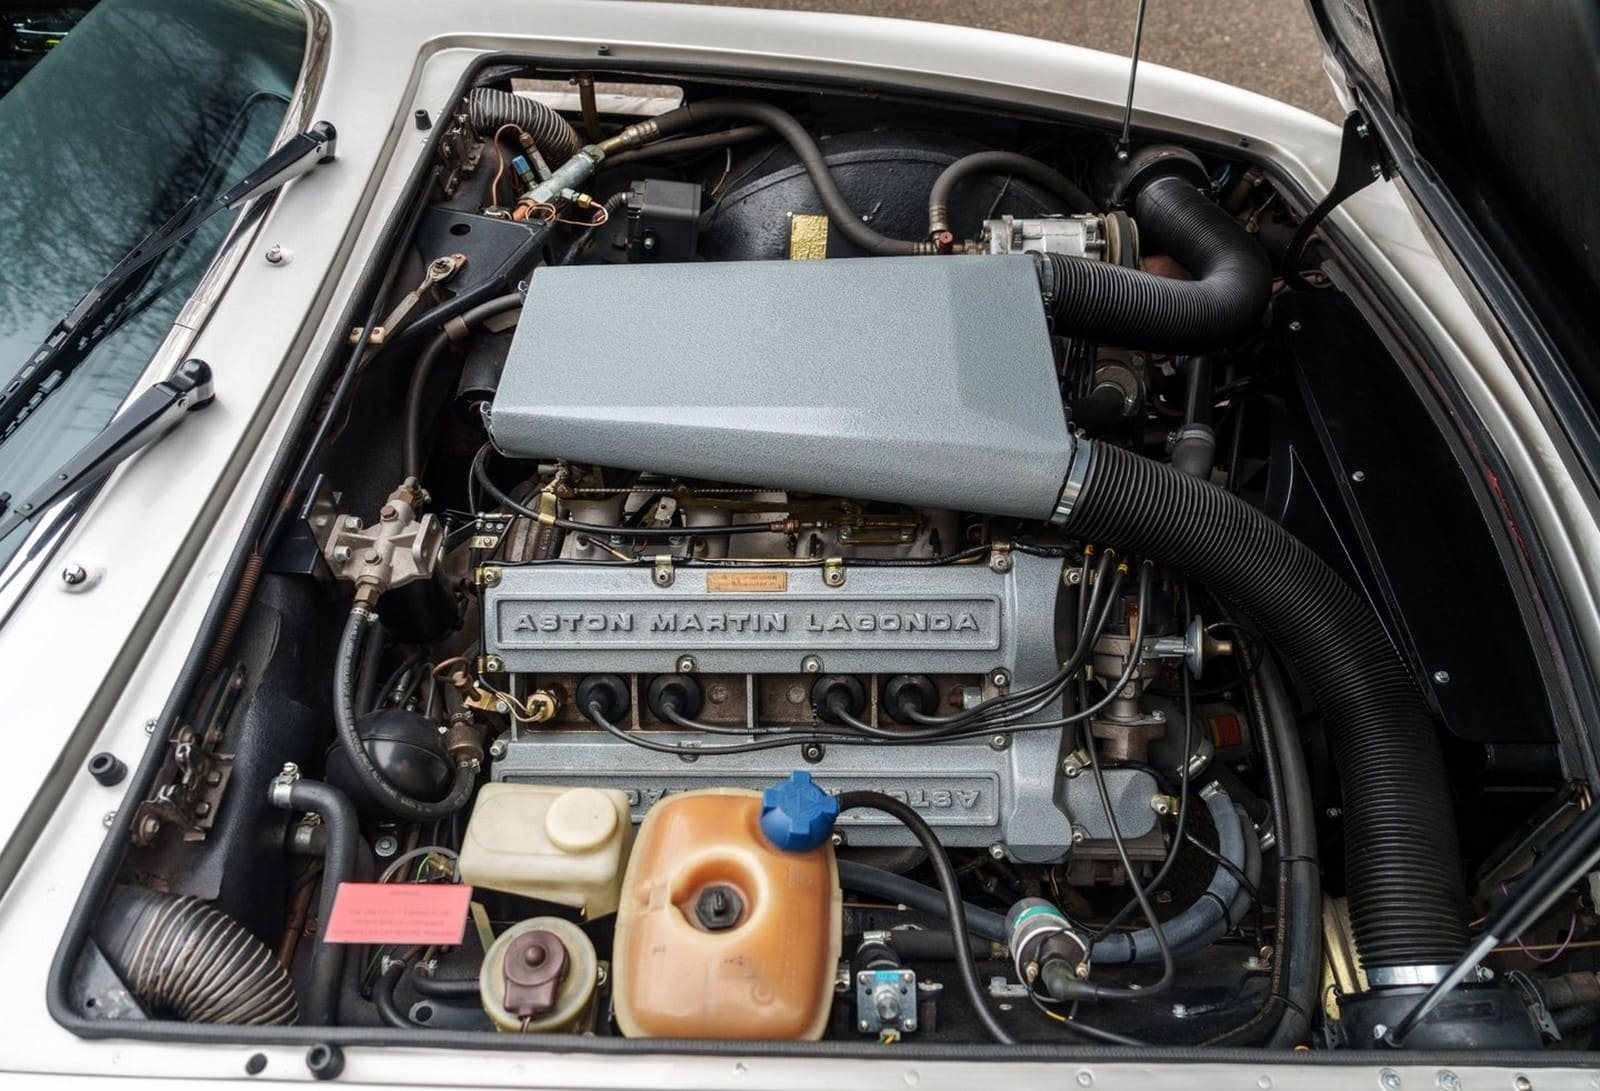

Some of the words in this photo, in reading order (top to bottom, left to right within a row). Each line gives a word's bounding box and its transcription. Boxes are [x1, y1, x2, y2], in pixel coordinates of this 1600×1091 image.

[513, 611, 635, 632] ASTON
[649, 611, 787, 632] MARTIN
[804, 611, 980, 632] LAGONDA
[865, 789, 980, 809] ASTO
